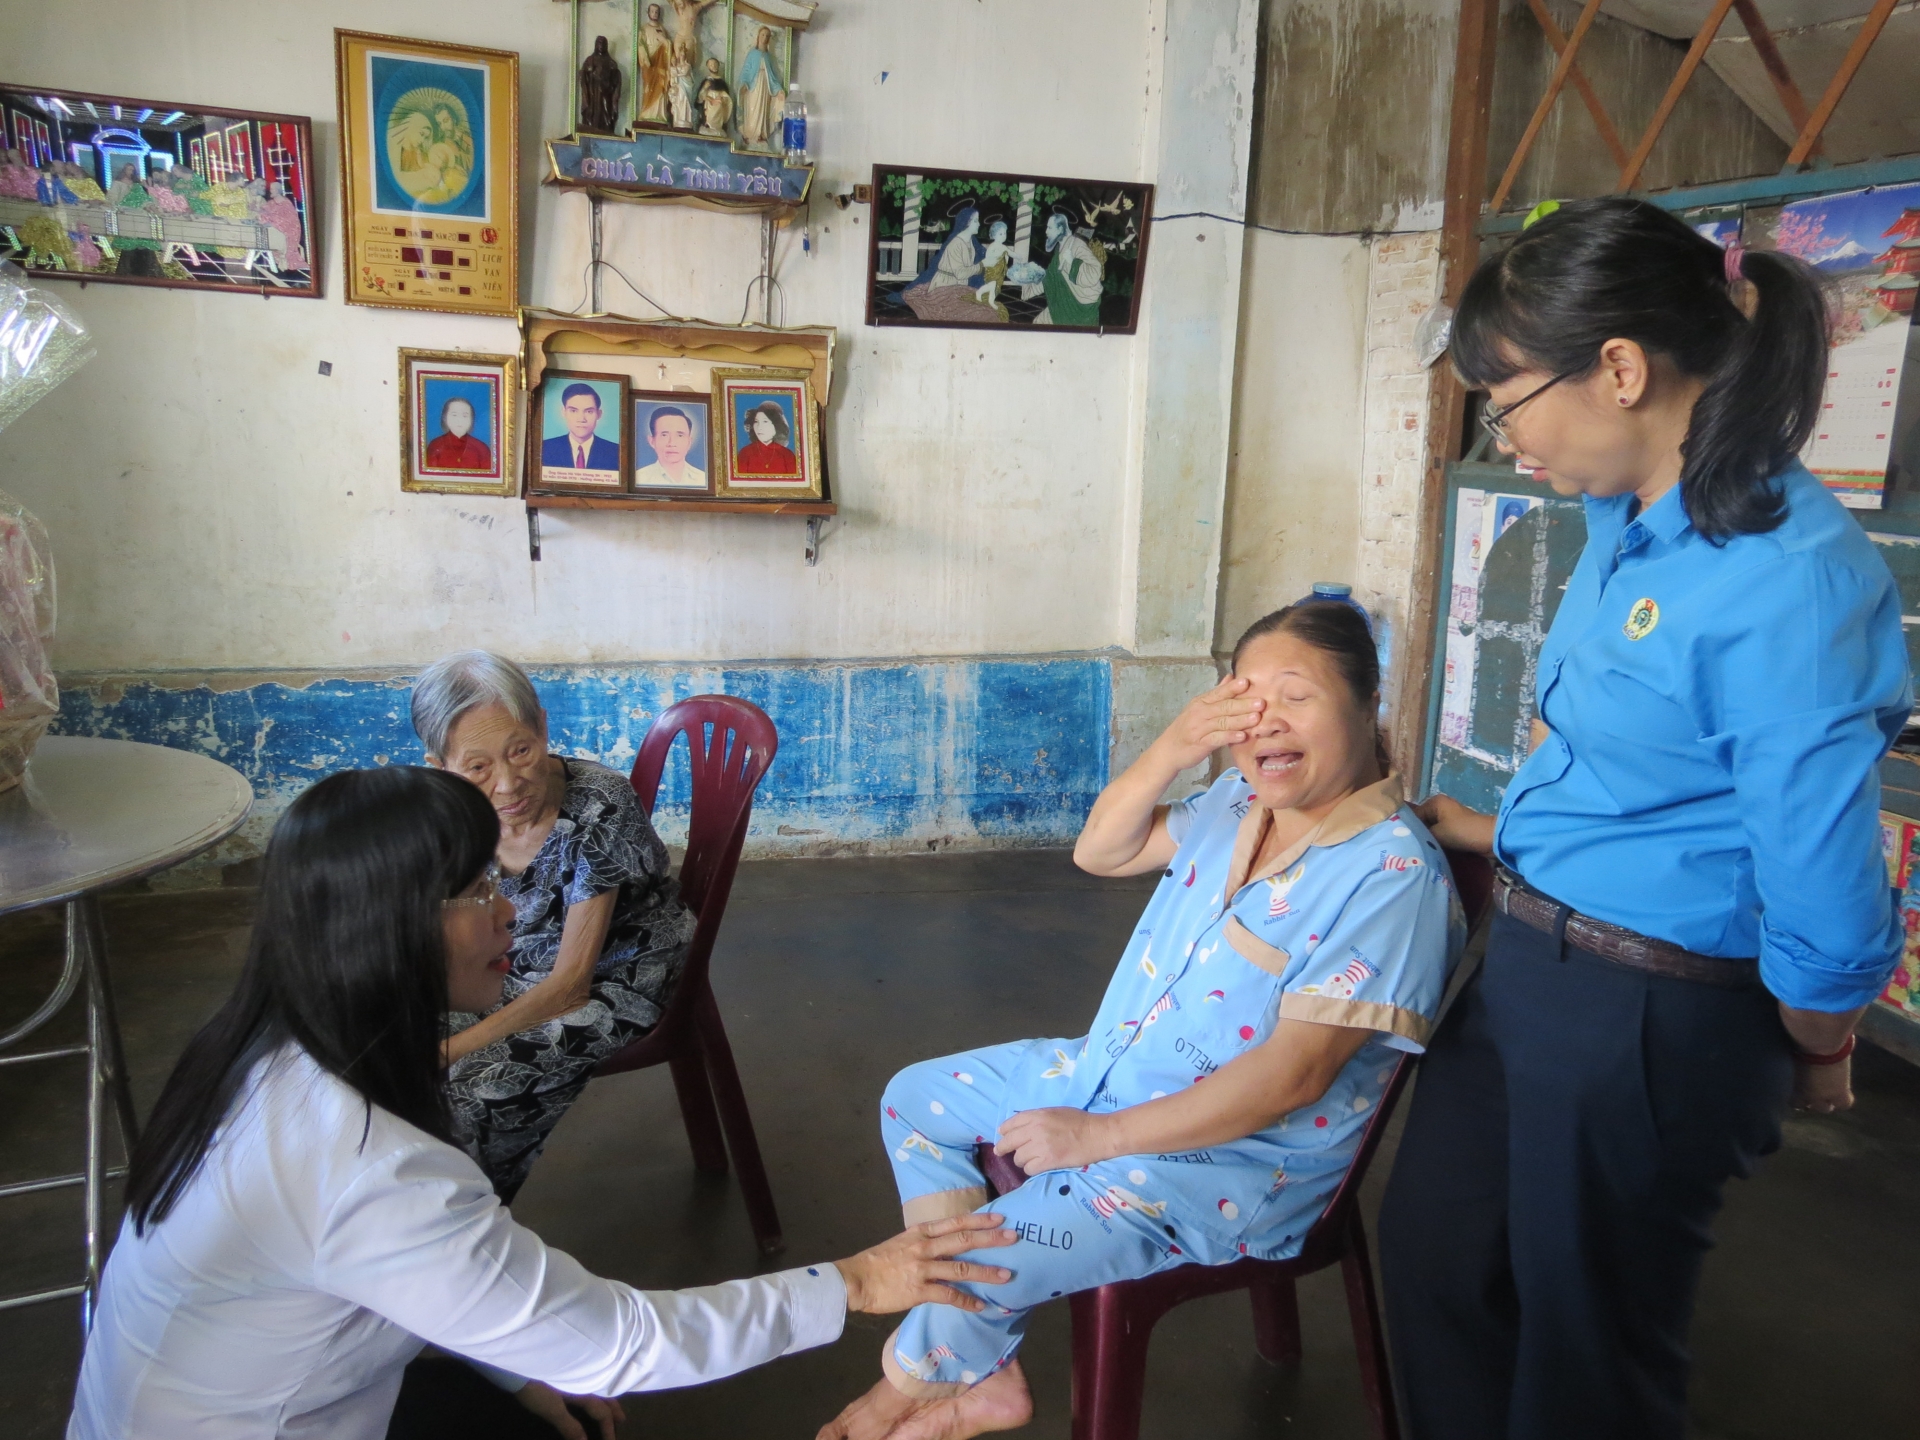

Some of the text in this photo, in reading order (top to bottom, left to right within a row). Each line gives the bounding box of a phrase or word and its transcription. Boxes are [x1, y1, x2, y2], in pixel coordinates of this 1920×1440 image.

[581, 152, 782, 197] CHÚA LÀ TÌNH YÊU
[1263, 914, 1286, 926] Rabbit
[1349, 945, 1383, 978] Rabbit Sun
[1174, 1037, 1219, 1074] HELLO
[1080, 1197, 1113, 1235] Rabbit Sun
[1015, 1220, 1073, 1250] HELLO
